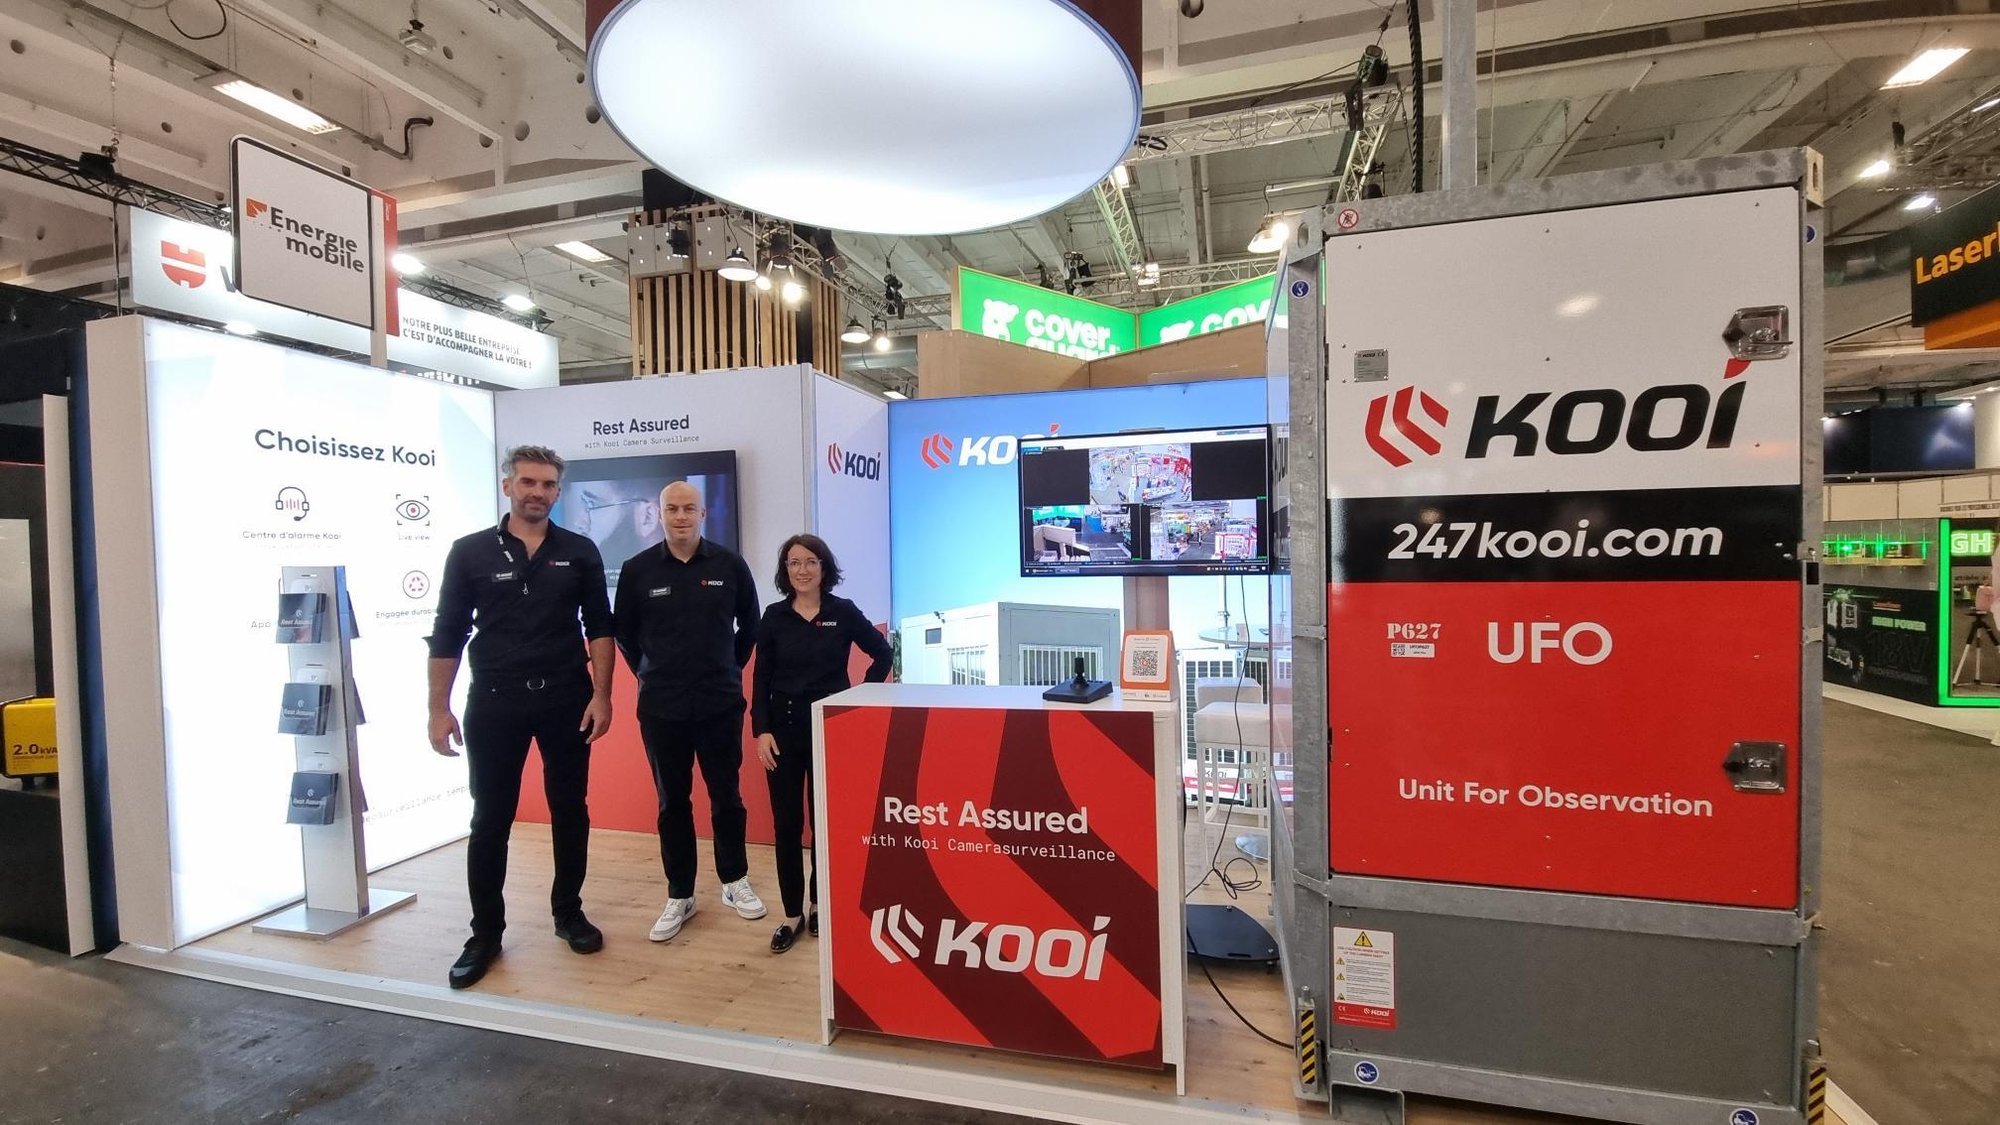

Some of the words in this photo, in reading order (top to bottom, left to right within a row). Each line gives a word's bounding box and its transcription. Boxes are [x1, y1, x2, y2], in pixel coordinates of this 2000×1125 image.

[270, 206, 358, 253] Energie
[285, 236, 365, 273] mobile
[1916, 221, 2000, 285] Laser
[1025, 308, 1111, 351] cover
[1201, 298, 1271, 334] cov
[403, 316, 431, 331] NOTRE
[433, 323, 453, 337] PLUS
[455, 329, 477, 343] BELLE
[479, 337, 521, 355] ENTREPRISE
[403, 328, 425, 341] C'EST
[427, 334, 494, 360] D'ACCOMPAGNER
[495, 352, 504, 361] LA
[593, 420, 624, 435] Rest
[629, 414, 690, 433] Assured
[603, 440, 619, 448] Kooi
[623, 438, 647, 447] Camera
[650, 435, 700, 445] Surveillance
[254, 428, 385, 461] Choisissez
[392, 445, 436, 467] Kooi
[243, 530, 277, 539] Centre
[279, 530, 321, 540] d'alarme
[1387, 518, 1724, 560] 247kooi.com
[1387, 622, 1441, 640] P627
[1488, 621, 1613, 665] UFO
[884, 796, 948, 826] Rest
[958, 800, 1088, 834] Assured
[1399, 778, 1454, 801] Unit
[1463, 781, 1509, 805] For
[1518, 784, 1713, 817] Observation
[862, 833, 896, 847] with
[904, 836, 939, 850] Kooi
[948, 838, 1116, 862] Camerasurveillance
